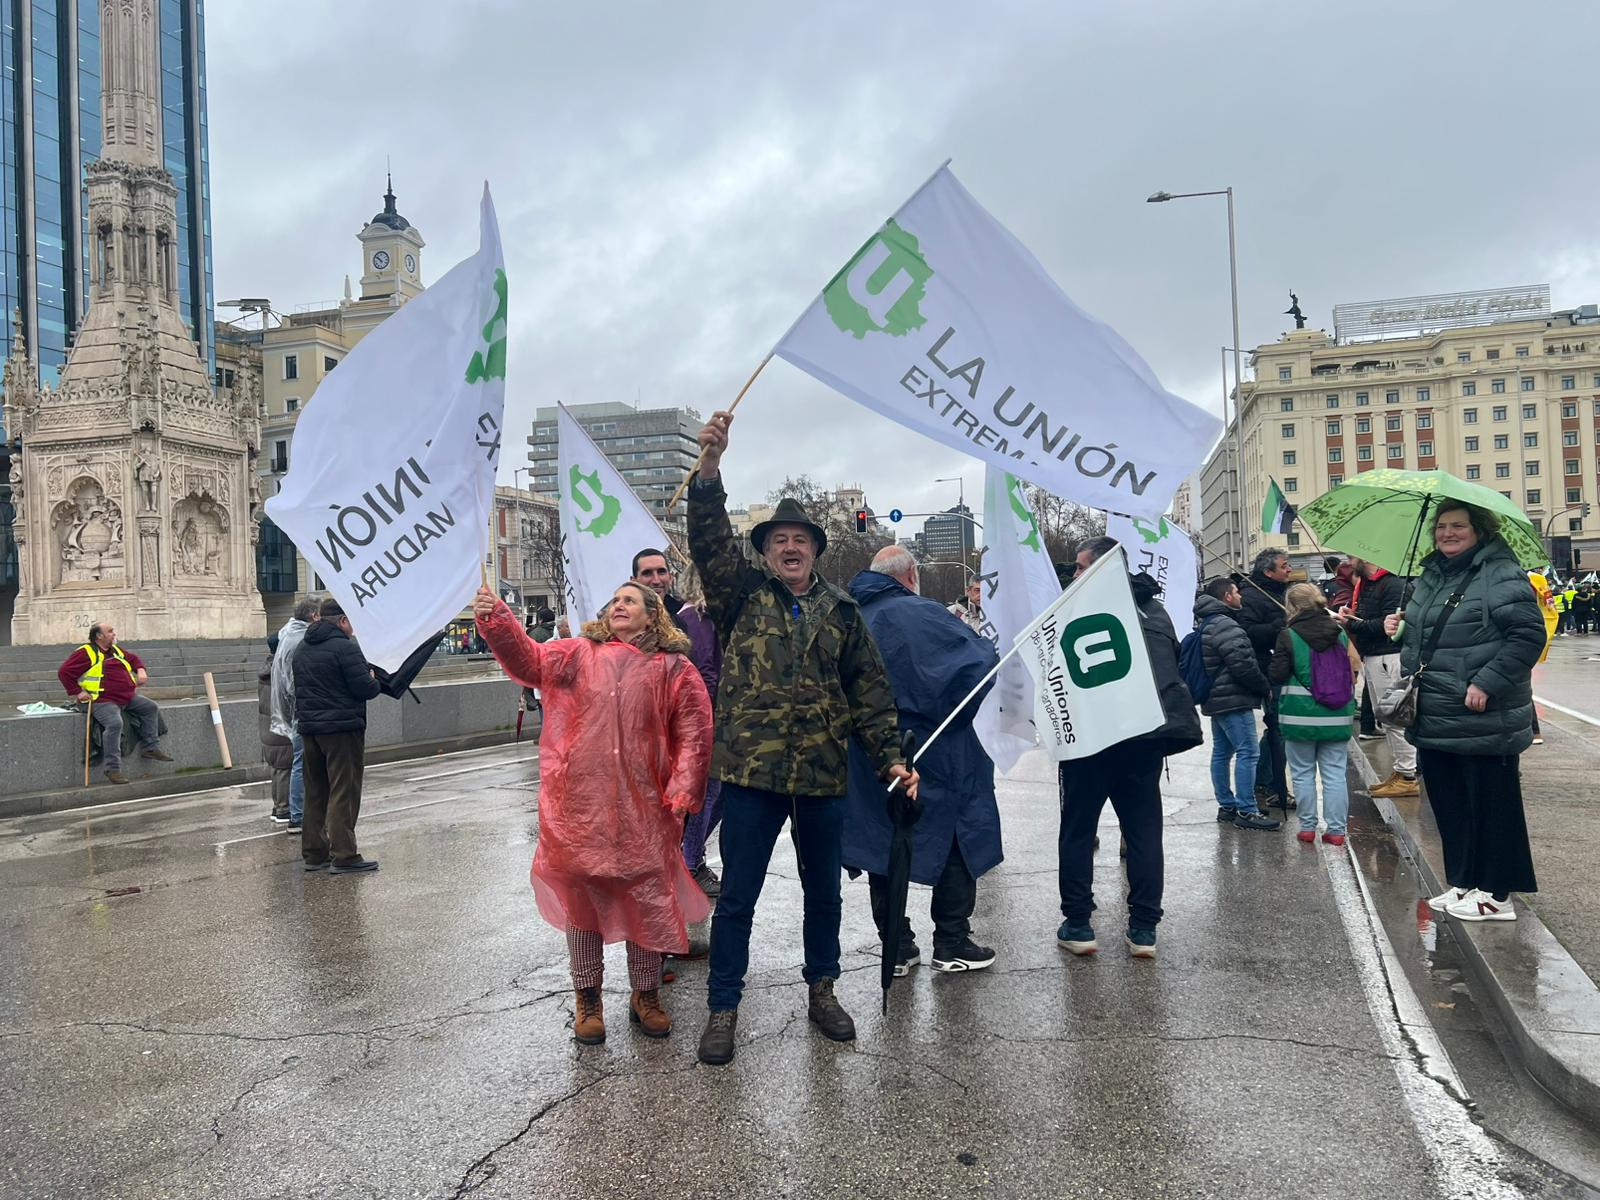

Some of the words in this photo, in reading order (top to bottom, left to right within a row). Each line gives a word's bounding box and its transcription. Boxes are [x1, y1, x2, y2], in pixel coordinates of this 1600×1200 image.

[899, 364, 1038, 466] EXTREM
[926, 326, 986, 400] LA
[993, 385, 1158, 496] UNIÓN
[1047, 666, 1076, 744] Uniones
